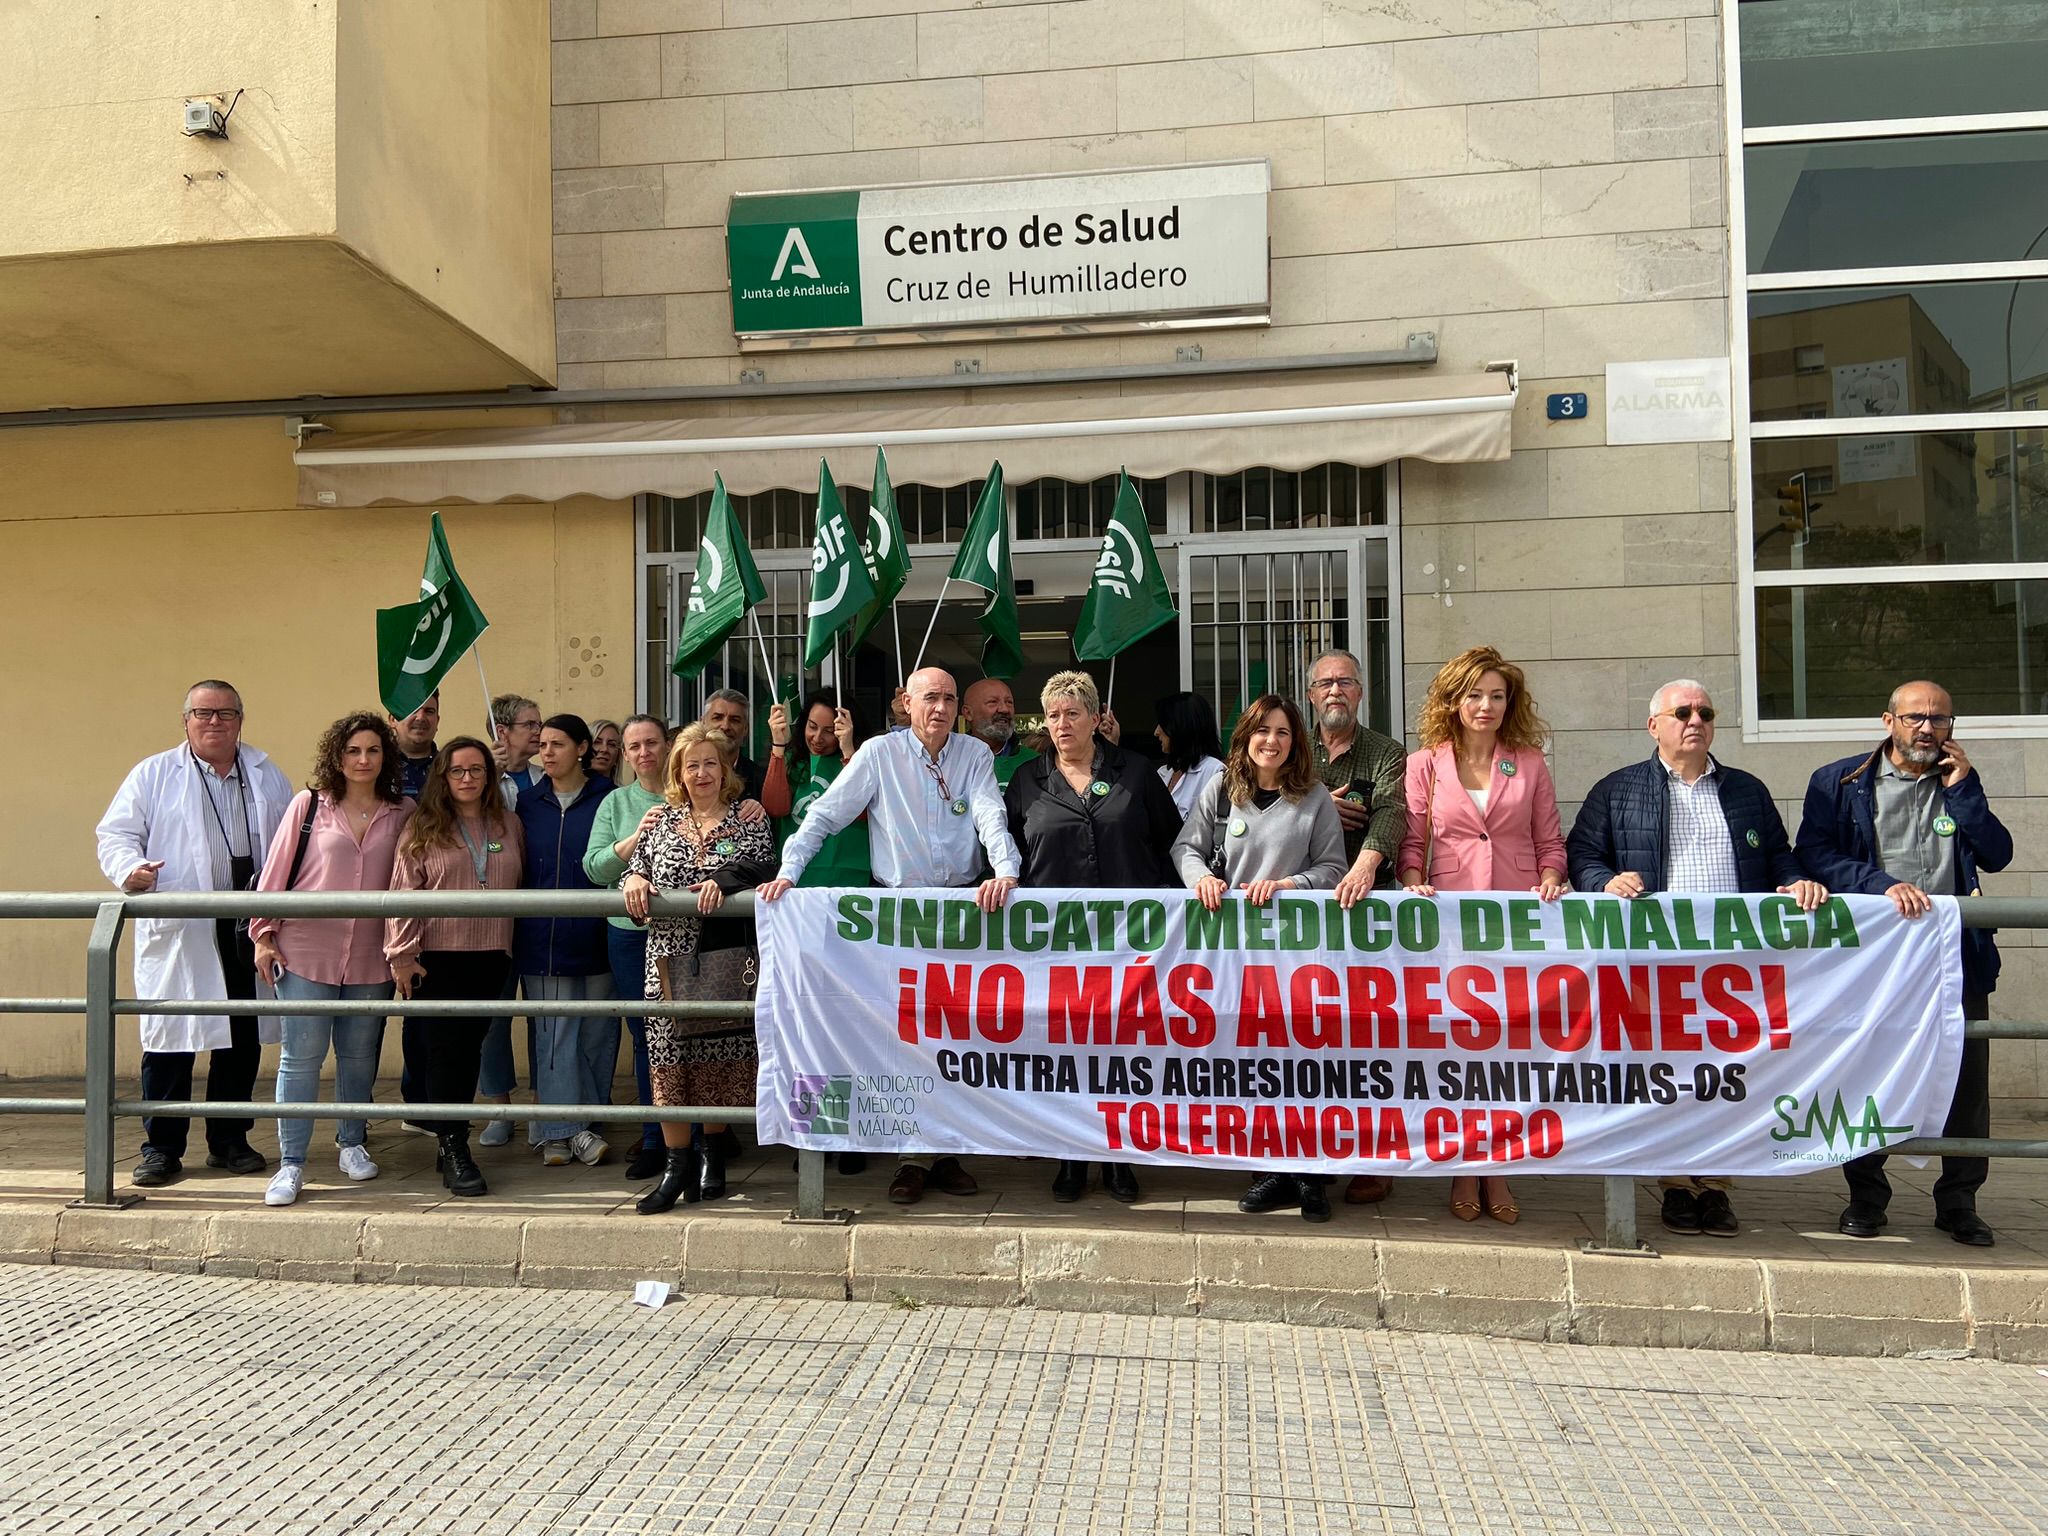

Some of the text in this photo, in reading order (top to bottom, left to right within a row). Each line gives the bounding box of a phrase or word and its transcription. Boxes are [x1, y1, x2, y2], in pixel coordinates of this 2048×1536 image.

[884, 205, 1181, 257] Centro de Salud
[741, 282, 850, 300] Junta de Andalucía
[886, 260, 1188, 304] Cruz de Humilladero
[1560, 396, 1574, 416] 3
[1612, 391, 1726, 412] ALARMA
[837, 894, 1165, 953] SINDICATO
[1460, 898, 1547, 951] DE
[897, 956, 1792, 1053] ¡NO MÁS AGRESIONES!
[857, 1074, 935, 1094] SINDICATO
[937, 1048, 1747, 1105] CONTRA LAS AGRESIONES A SANITARIAS-OS
[857, 1094, 915, 1115] MÉDICO
[858, 1115, 921, 1137] MÁLAGA
[1097, 1101, 1564, 1162] TOLERANCIA CERO
[1772, 1150, 1824, 1162] Sindicato
